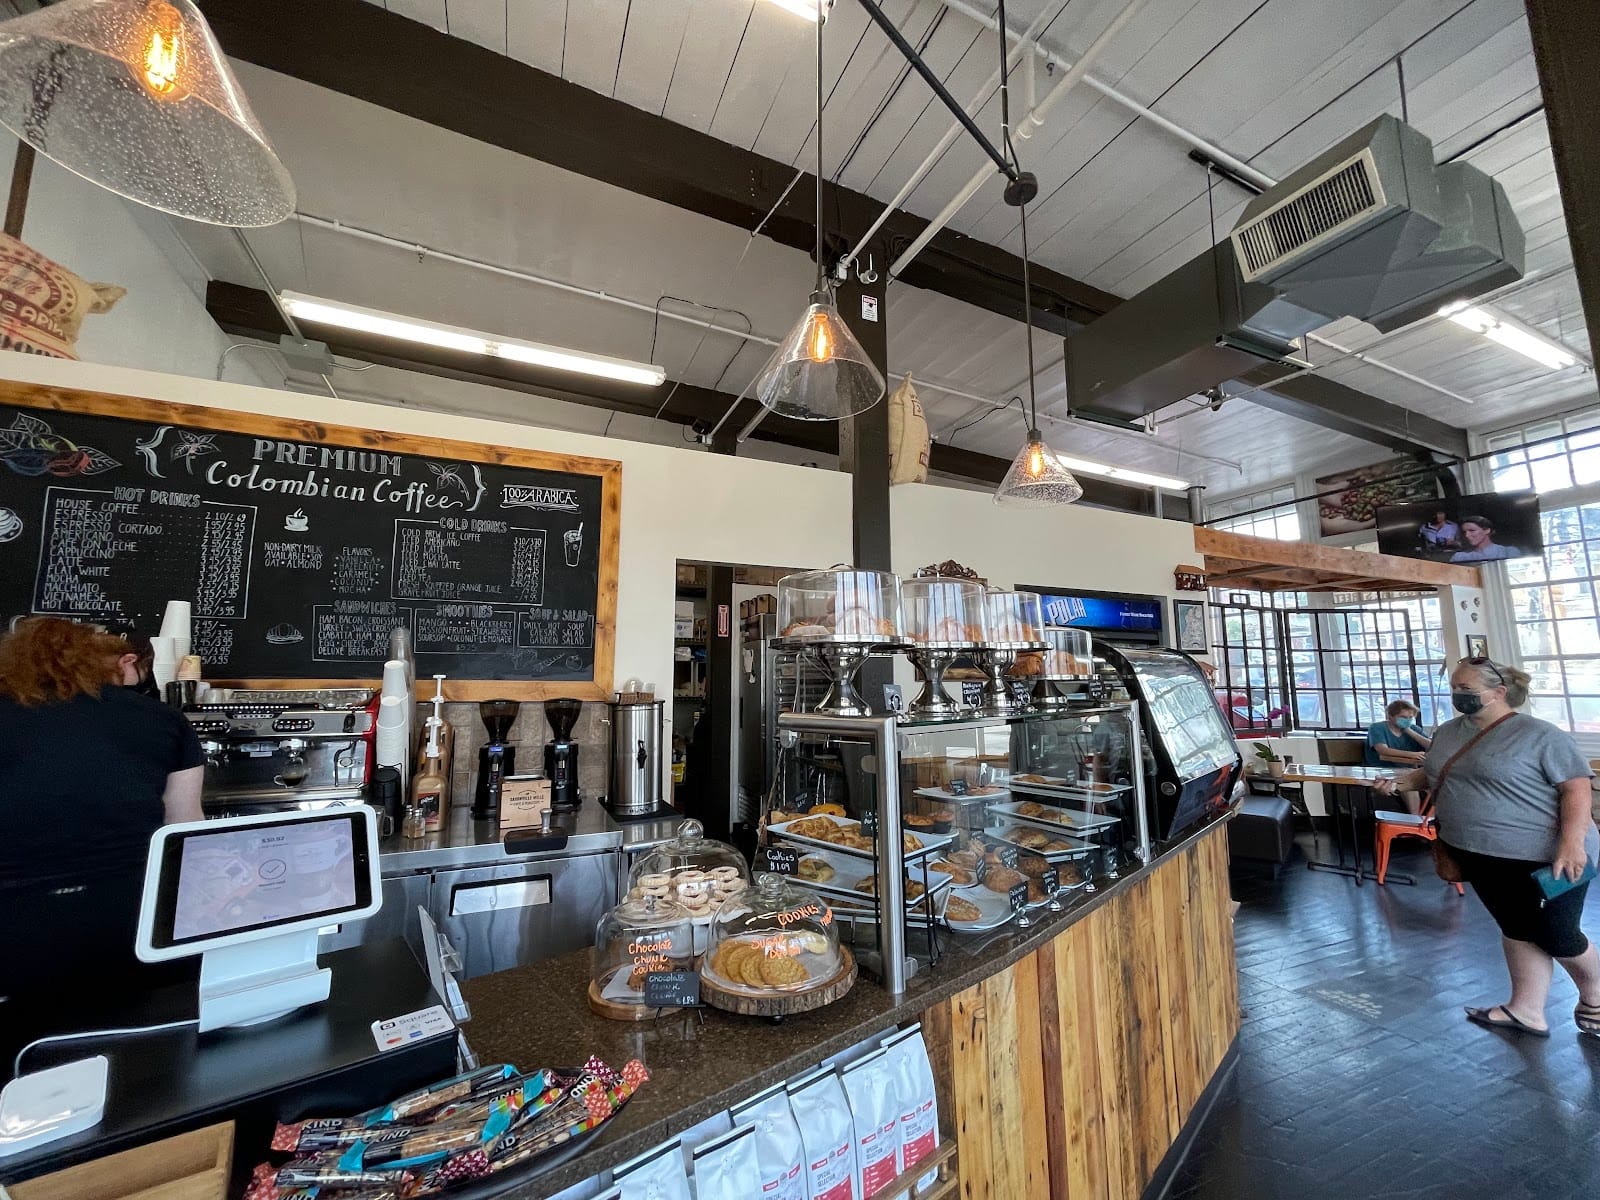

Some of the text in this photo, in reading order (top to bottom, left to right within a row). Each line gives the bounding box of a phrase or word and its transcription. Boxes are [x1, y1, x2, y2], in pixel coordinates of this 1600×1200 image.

[253, 437, 402, 476] PREMIUM
[206, 461, 463, 513] Colombian Coffee
[114, 487, 200, 507] HOT DRINKS
[56, 498, 92, 510] HOUSE
[101, 502, 140, 514] COFFEE
[55, 509, 112, 521] ESPRESSO
[54, 520, 111, 531] ESPRESSO
[118, 523, 162, 535] CORTADO
[440, 517, 468, 531] COLD
[52, 530, 113, 541] AMERICANO
[402, 528, 420, 537] COLD
[81, 540, 100, 549] CON
[107, 541, 138, 551] LECHE
[50, 547, 114, 559] CAPPUCCINO
[264, 551, 306, 560] AVAILABLE
[50, 556, 83, 567] LATTE
[286, 560, 322, 570] ALMOND
[48, 566, 72, 575] FLAT
[79, 566, 110, 576] WHITE
[46, 574, 78, 583] MOCHA
[44, 582, 100, 592] MACCHIATO
[43, 592, 106, 601] VIETNAMESE
[42, 600, 61, 609] HOT
[69, 601, 121, 610] CHOCOLATE
[1046, 598, 1088, 624] POLAR
[398, 1010, 438, 1024] Square
[570, 1074, 597, 1098] KIND
[302, 1119, 342, 1131] KIND
